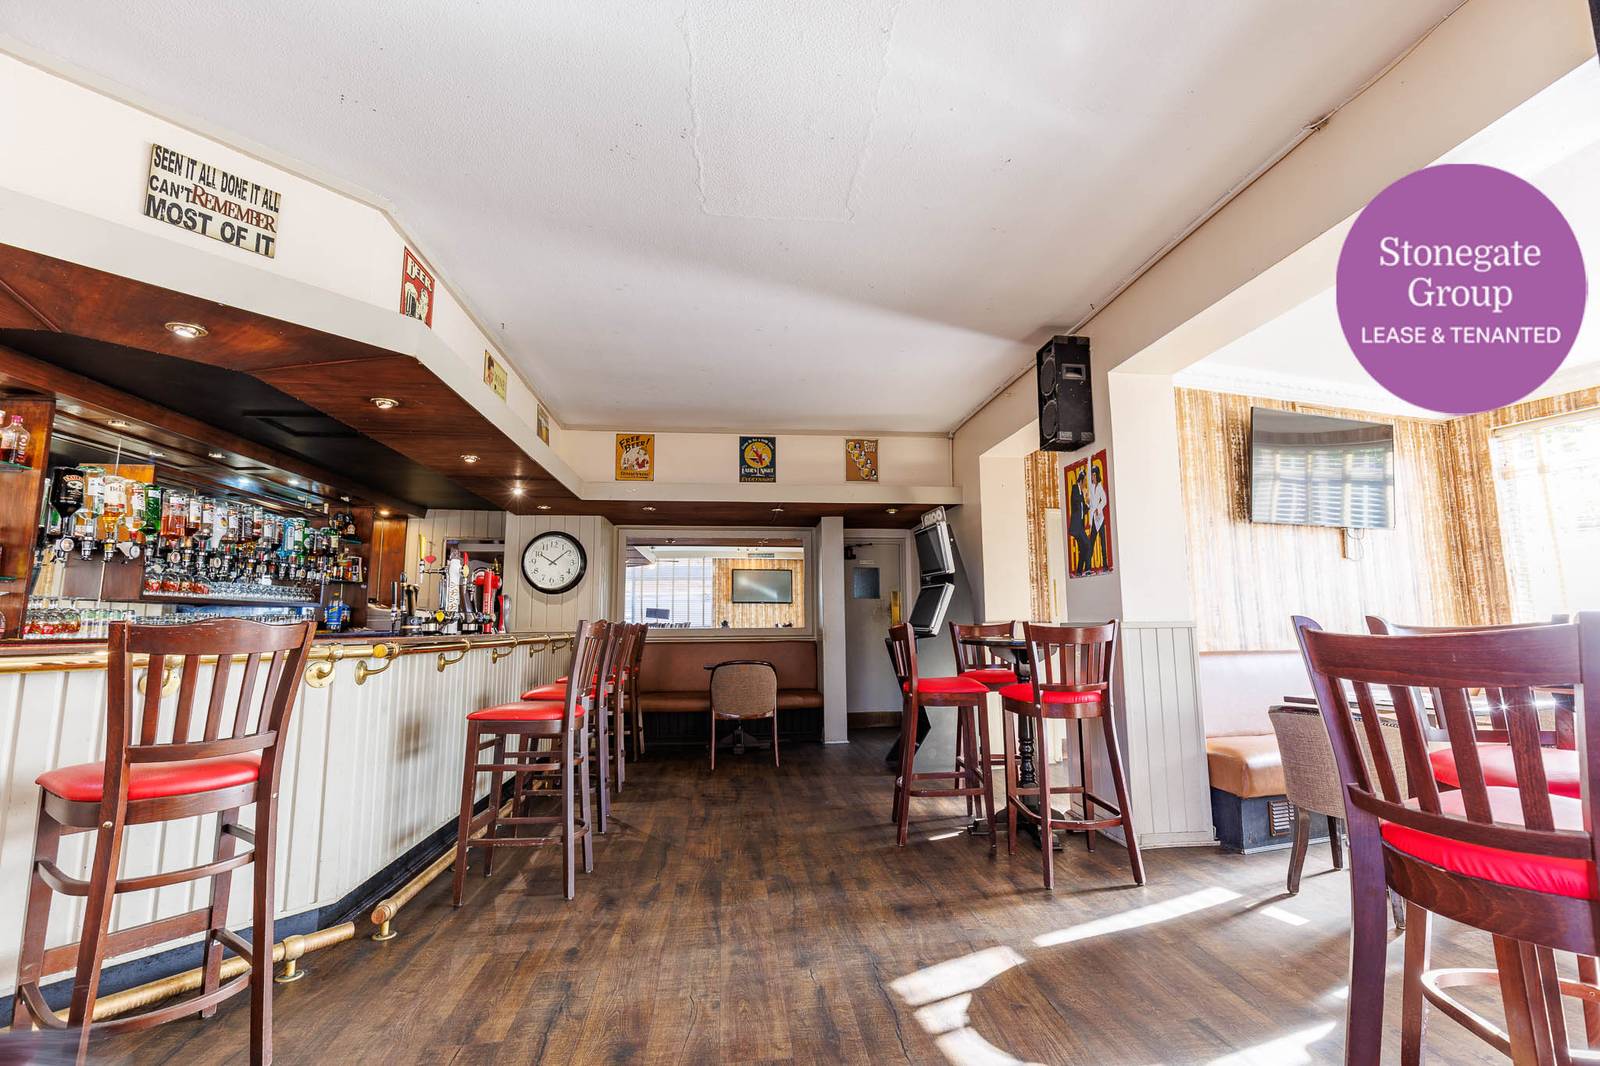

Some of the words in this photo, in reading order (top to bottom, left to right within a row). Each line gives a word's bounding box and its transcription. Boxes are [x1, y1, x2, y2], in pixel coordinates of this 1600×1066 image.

[149, 174, 193, 203] CAN'T
[191, 183, 277, 233] REMEMBER
[154, 145, 183, 176] SEEN
[186, 157, 197, 180] IT
[198, 164, 217, 188] ALL
[221, 171, 248, 200] DONE
[250, 183, 260, 204] IT
[262, 188, 279, 212] ALL
[146, 194, 212, 235] MOST
[220, 221, 248, 246] OF
[255, 232, 275, 256] IT
[406, 255, 432, 291] BEER
[619, 435, 640, 449] FREE
